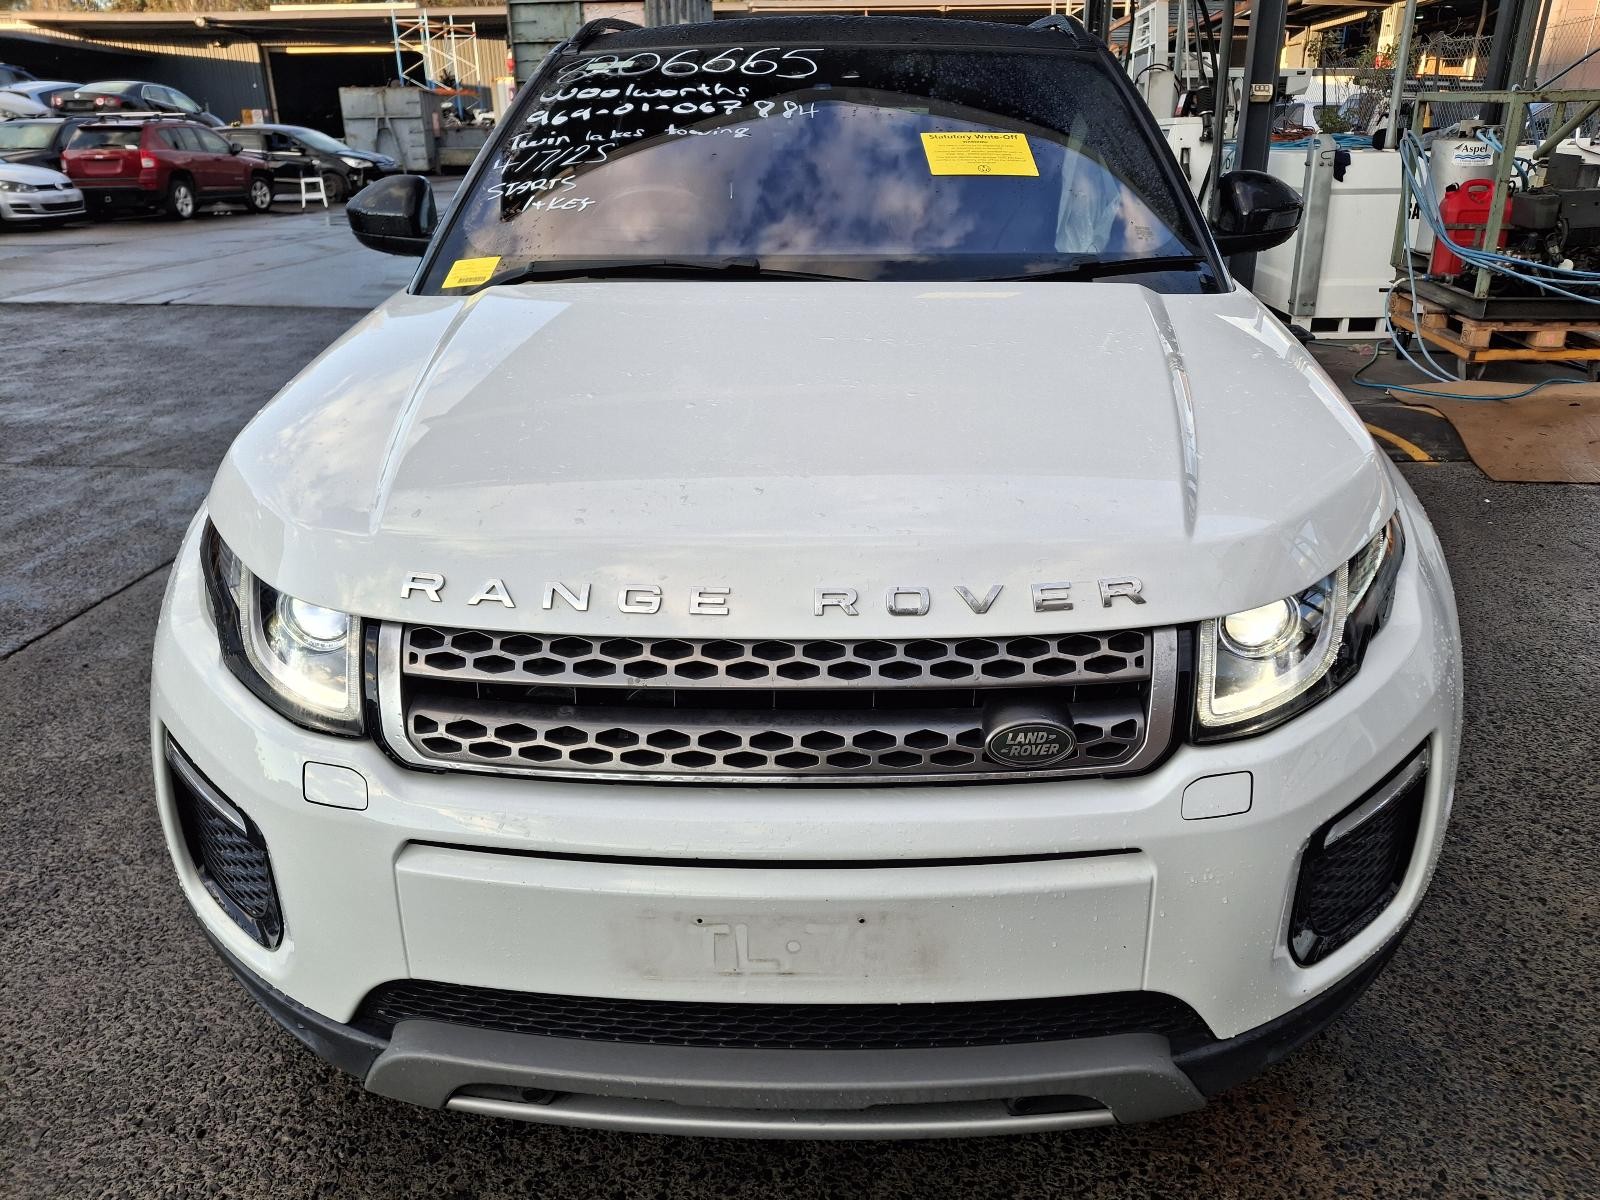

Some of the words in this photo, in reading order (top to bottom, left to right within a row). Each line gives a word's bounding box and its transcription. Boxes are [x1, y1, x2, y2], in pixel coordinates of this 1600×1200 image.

[510, 131, 571, 151] Twin
[664, 124, 752, 139] towing
[1461, 143, 1489, 155] Aspel
[487, 175, 577, 200] STARTS
[400, 570, 731, 616] RANGE
[813, 575, 1147, 617] ROVER
